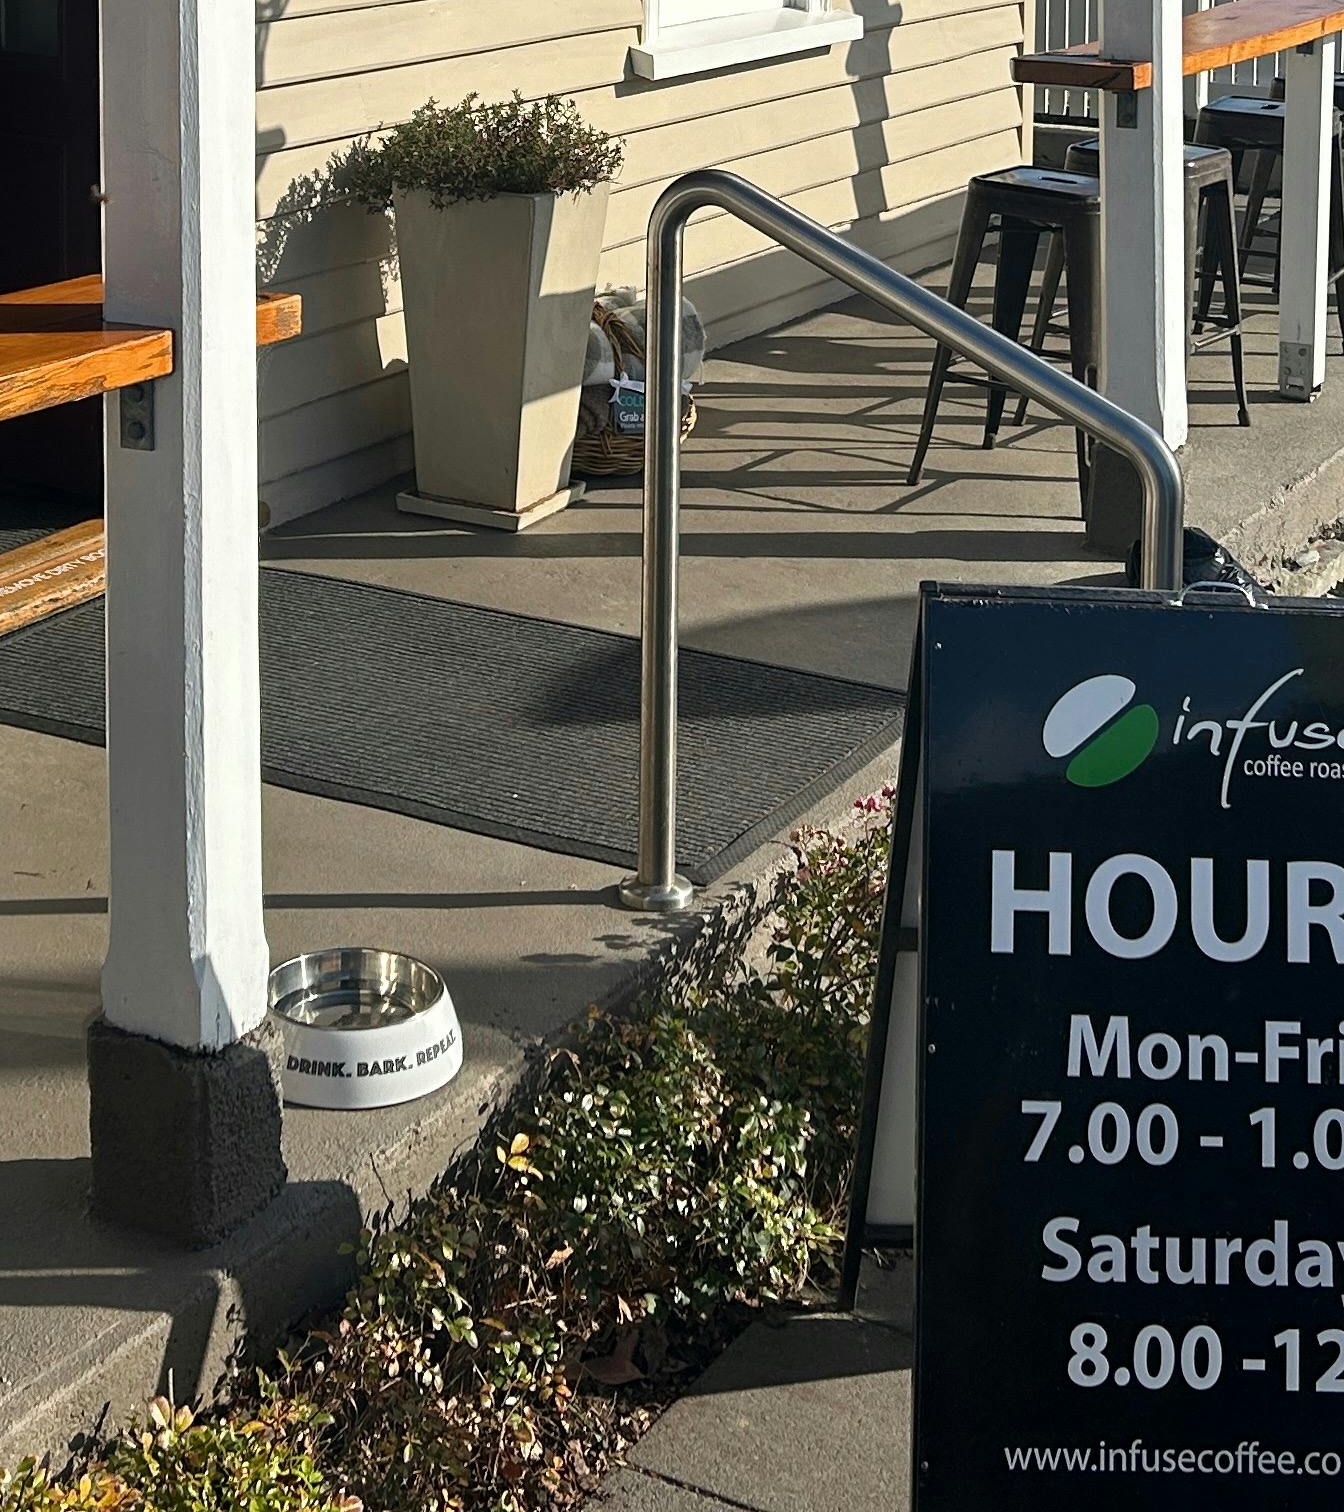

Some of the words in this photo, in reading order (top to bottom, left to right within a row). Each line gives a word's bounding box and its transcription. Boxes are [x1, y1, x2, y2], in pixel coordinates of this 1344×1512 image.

[619, 411, 639, 422] Grab
[1243, 755, 1305, 778] coffee
[286, 1055, 352, 1078] DRINK.
[356, 1056, 413, 1077] BARK.
[1021, 1100, 1179, 1166] 7.00
[1200, 1135, 1223, 1148] -
[1067, 1322, 1223, 1390] 8.00
